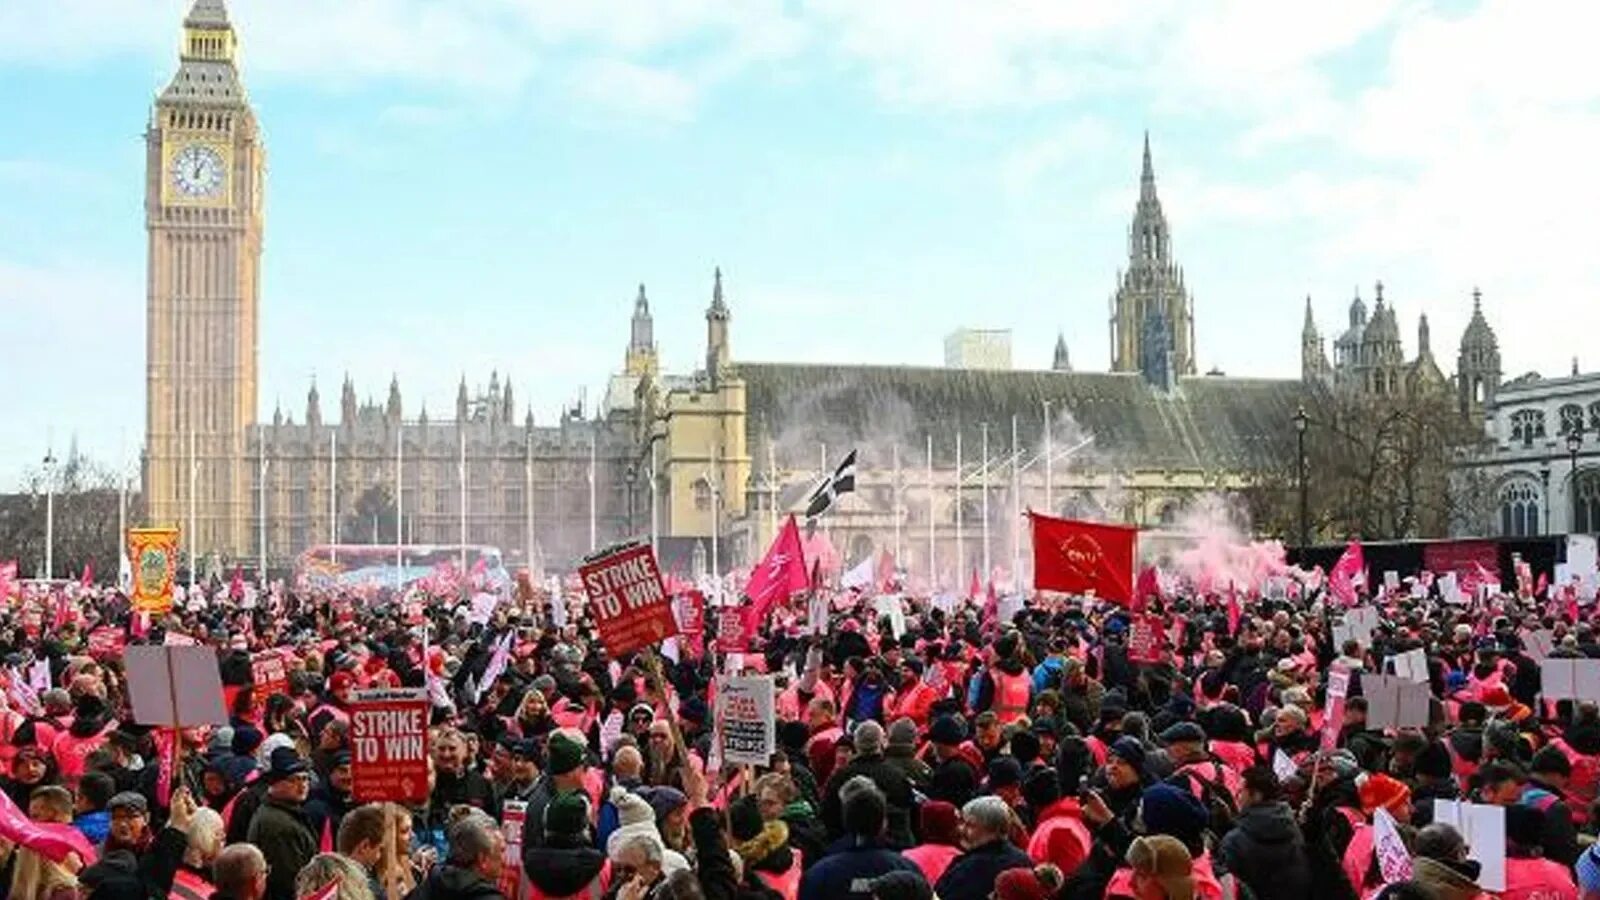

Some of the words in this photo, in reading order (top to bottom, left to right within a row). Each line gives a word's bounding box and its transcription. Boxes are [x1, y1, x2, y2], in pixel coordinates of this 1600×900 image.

[587, 554, 656, 595] STRIKE
[593, 592, 621, 619] TO
[623, 578, 664, 609] WIN
[353, 709, 423, 736] STRIKE
[353, 737, 379, 763] TO
[385, 735, 424, 761] WIN
